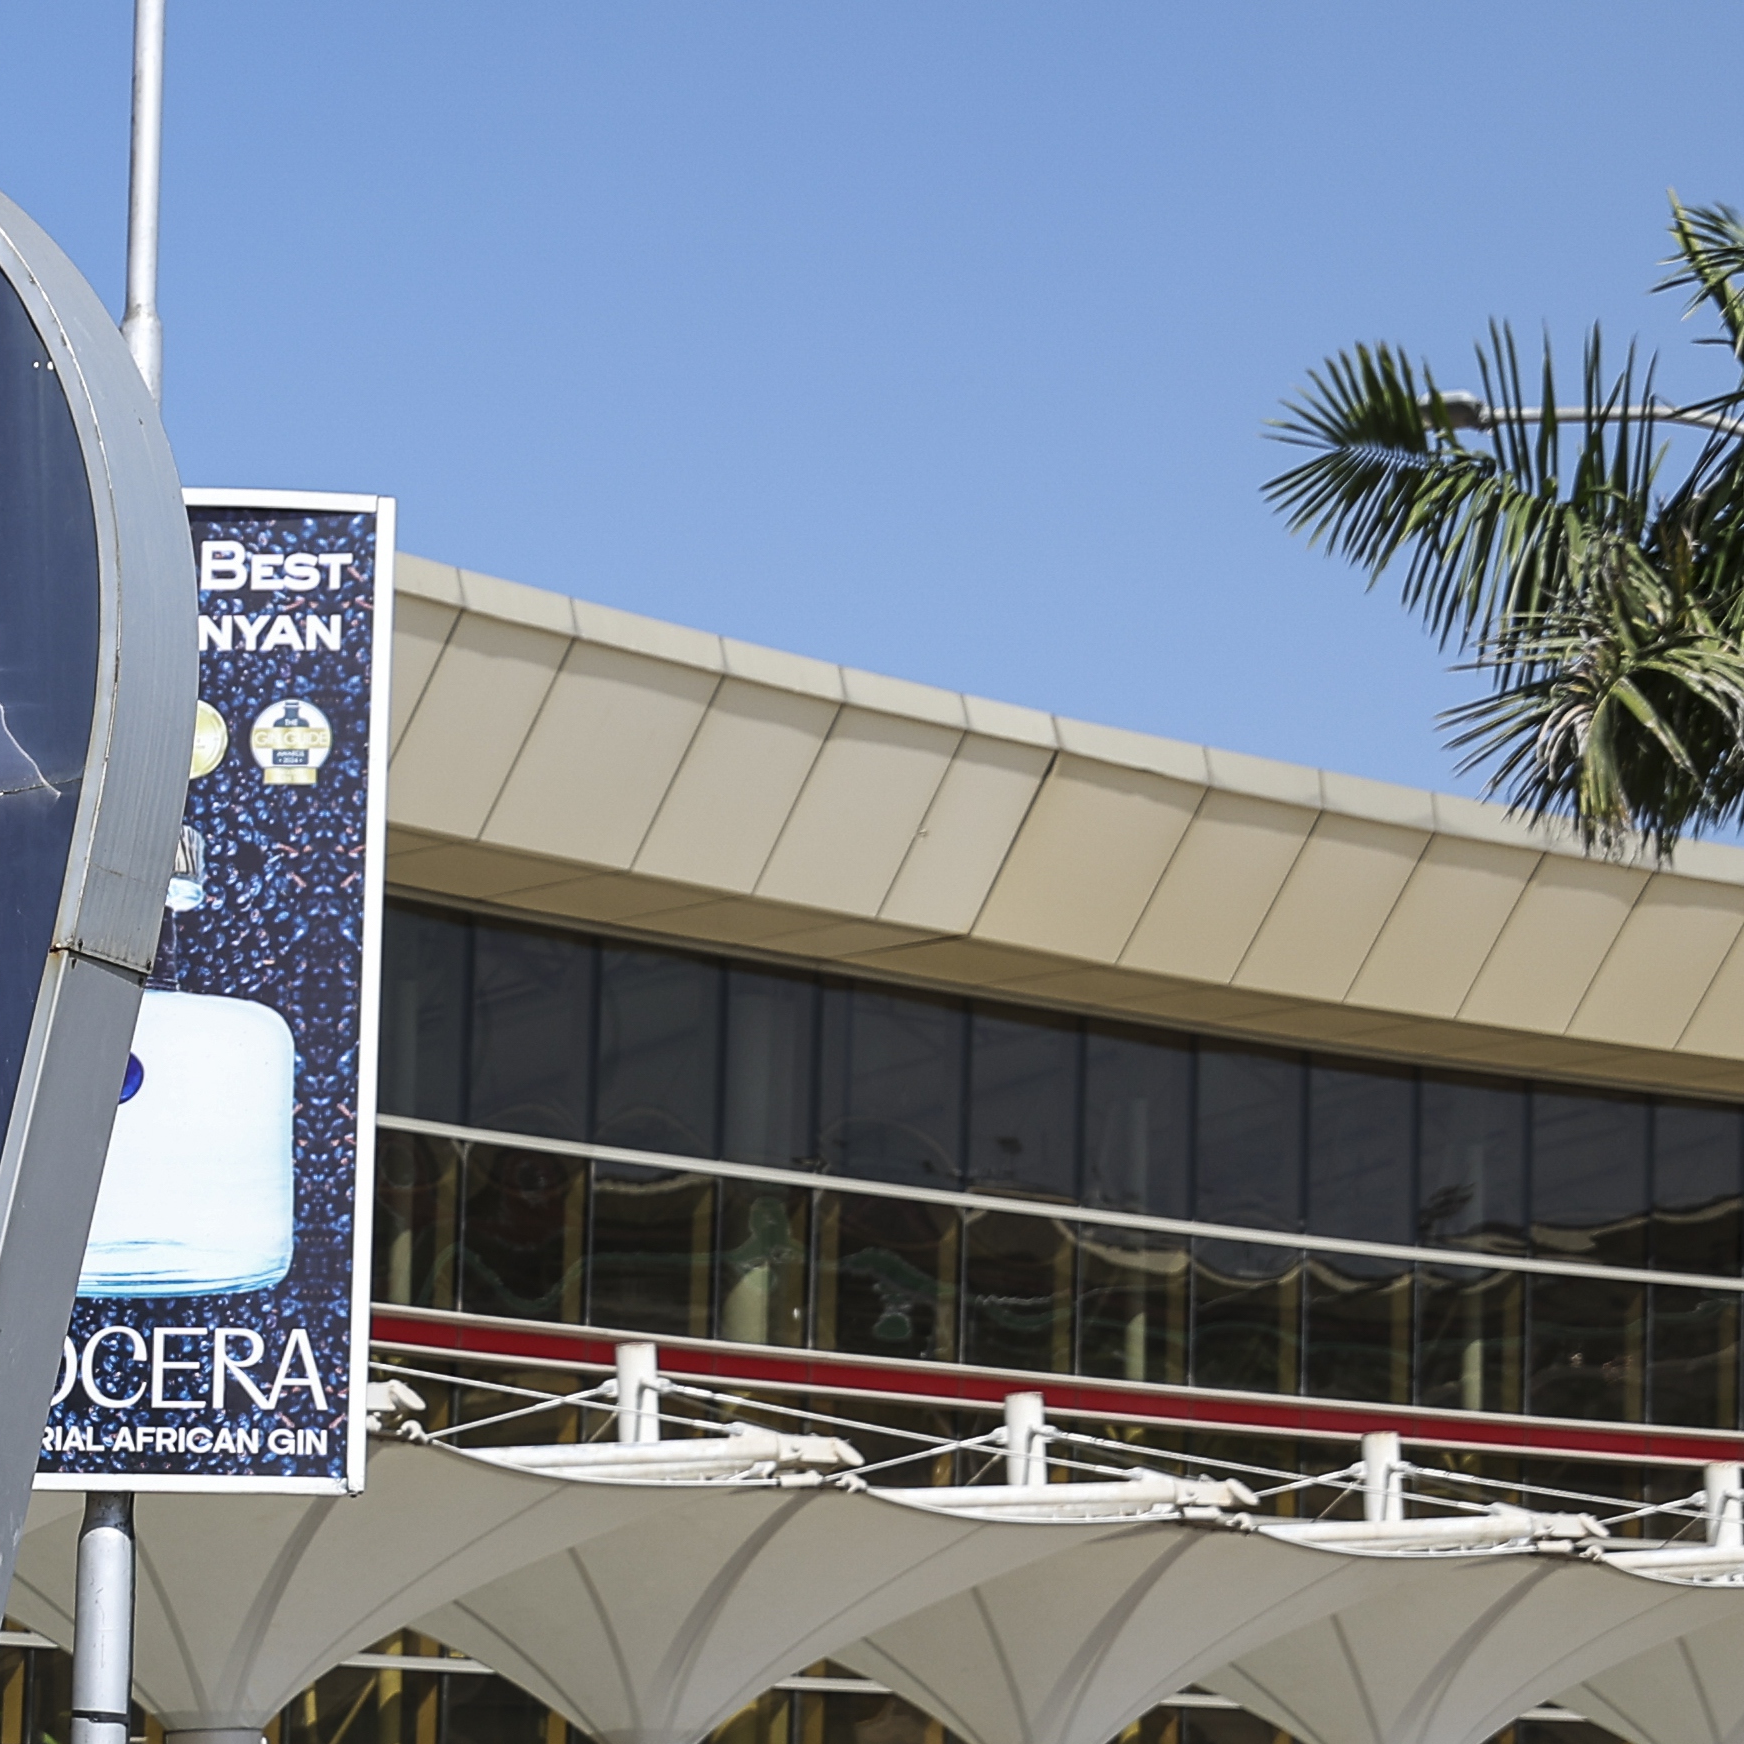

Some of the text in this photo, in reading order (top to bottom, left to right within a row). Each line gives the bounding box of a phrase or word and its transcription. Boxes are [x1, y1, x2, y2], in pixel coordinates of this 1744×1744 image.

[200, 540, 354, 591] Best
[198, 615, 342, 651] NYAN
[284, 731, 328, 746] GUIDE
[51, 1325, 328, 1410] CERA
[42, 1425, 328, 1455] RIAL AFRICAN GIN
